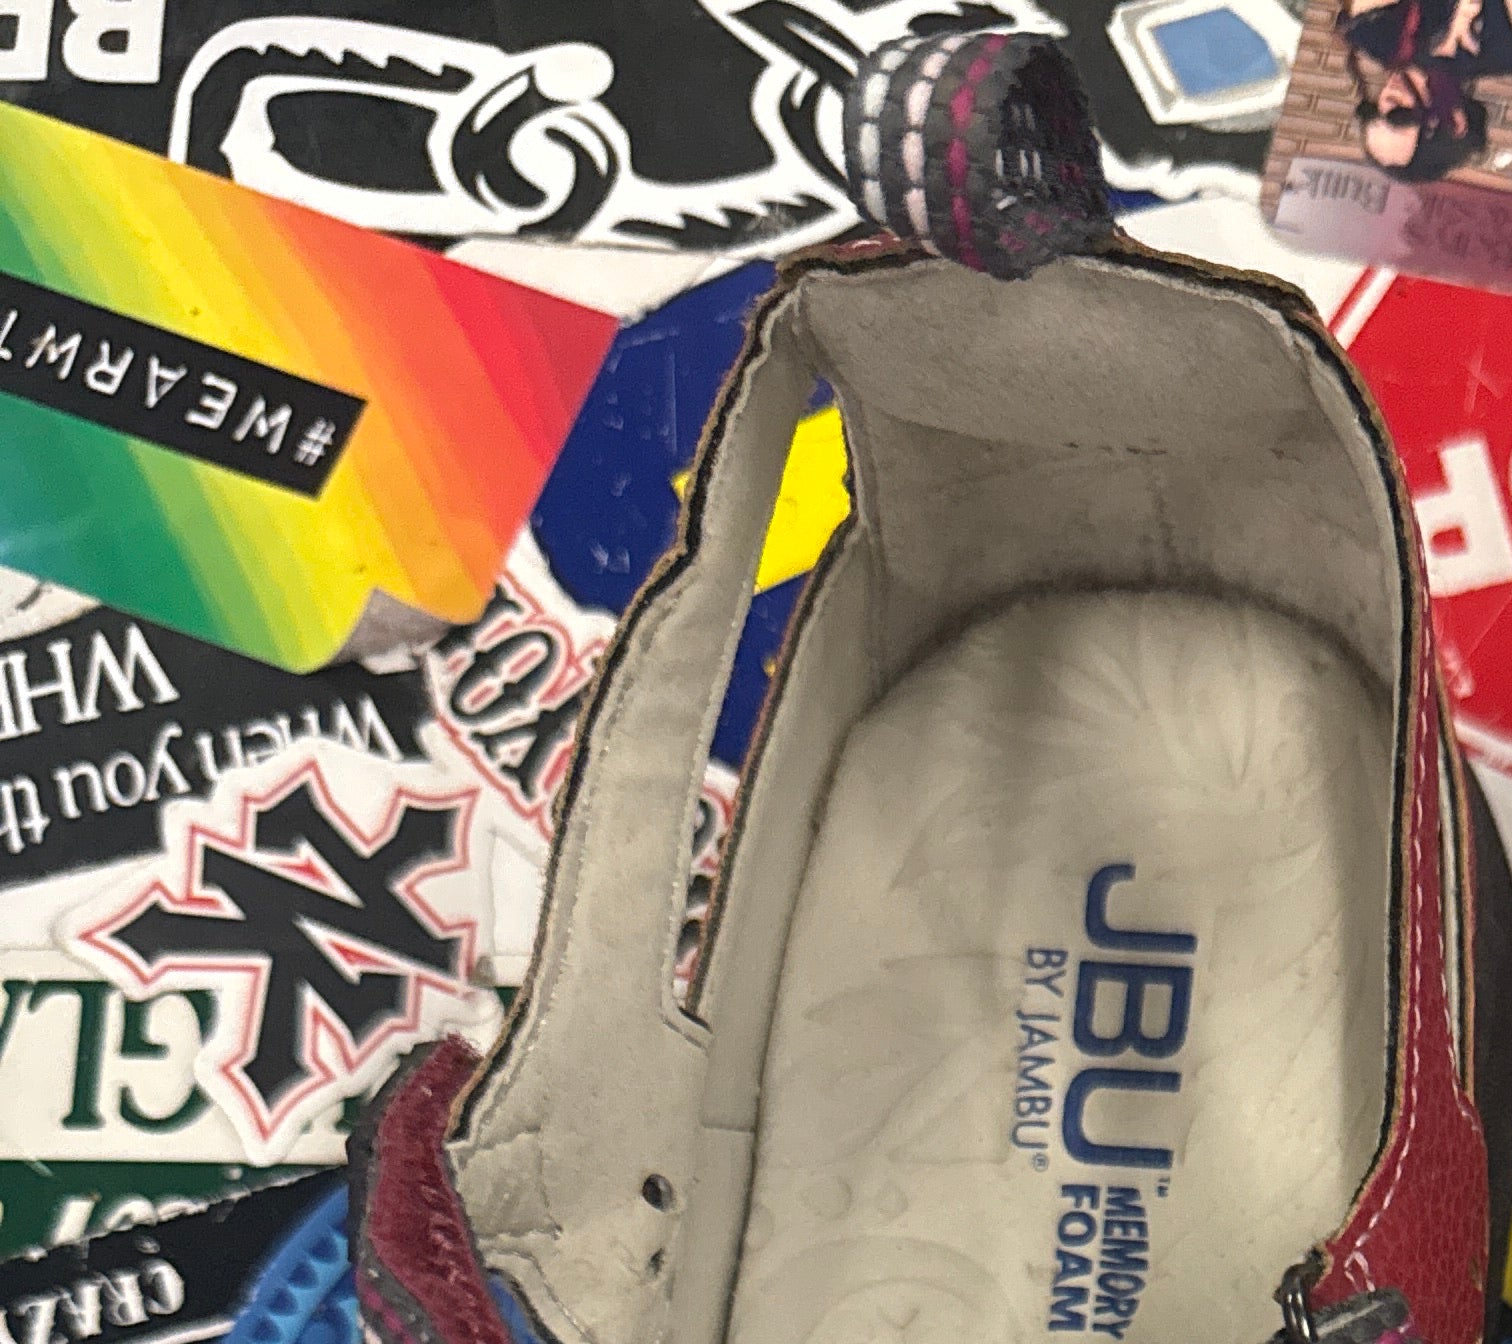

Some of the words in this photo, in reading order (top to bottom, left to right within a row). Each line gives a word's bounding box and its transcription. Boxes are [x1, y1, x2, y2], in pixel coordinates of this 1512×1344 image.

[57, 718, 191, 814] you
[1025, 946, 1069, 998] BY
[1047, 1183, 1099, 1334] FOAM
[1092, 1186, 1150, 1342] MEMORY
